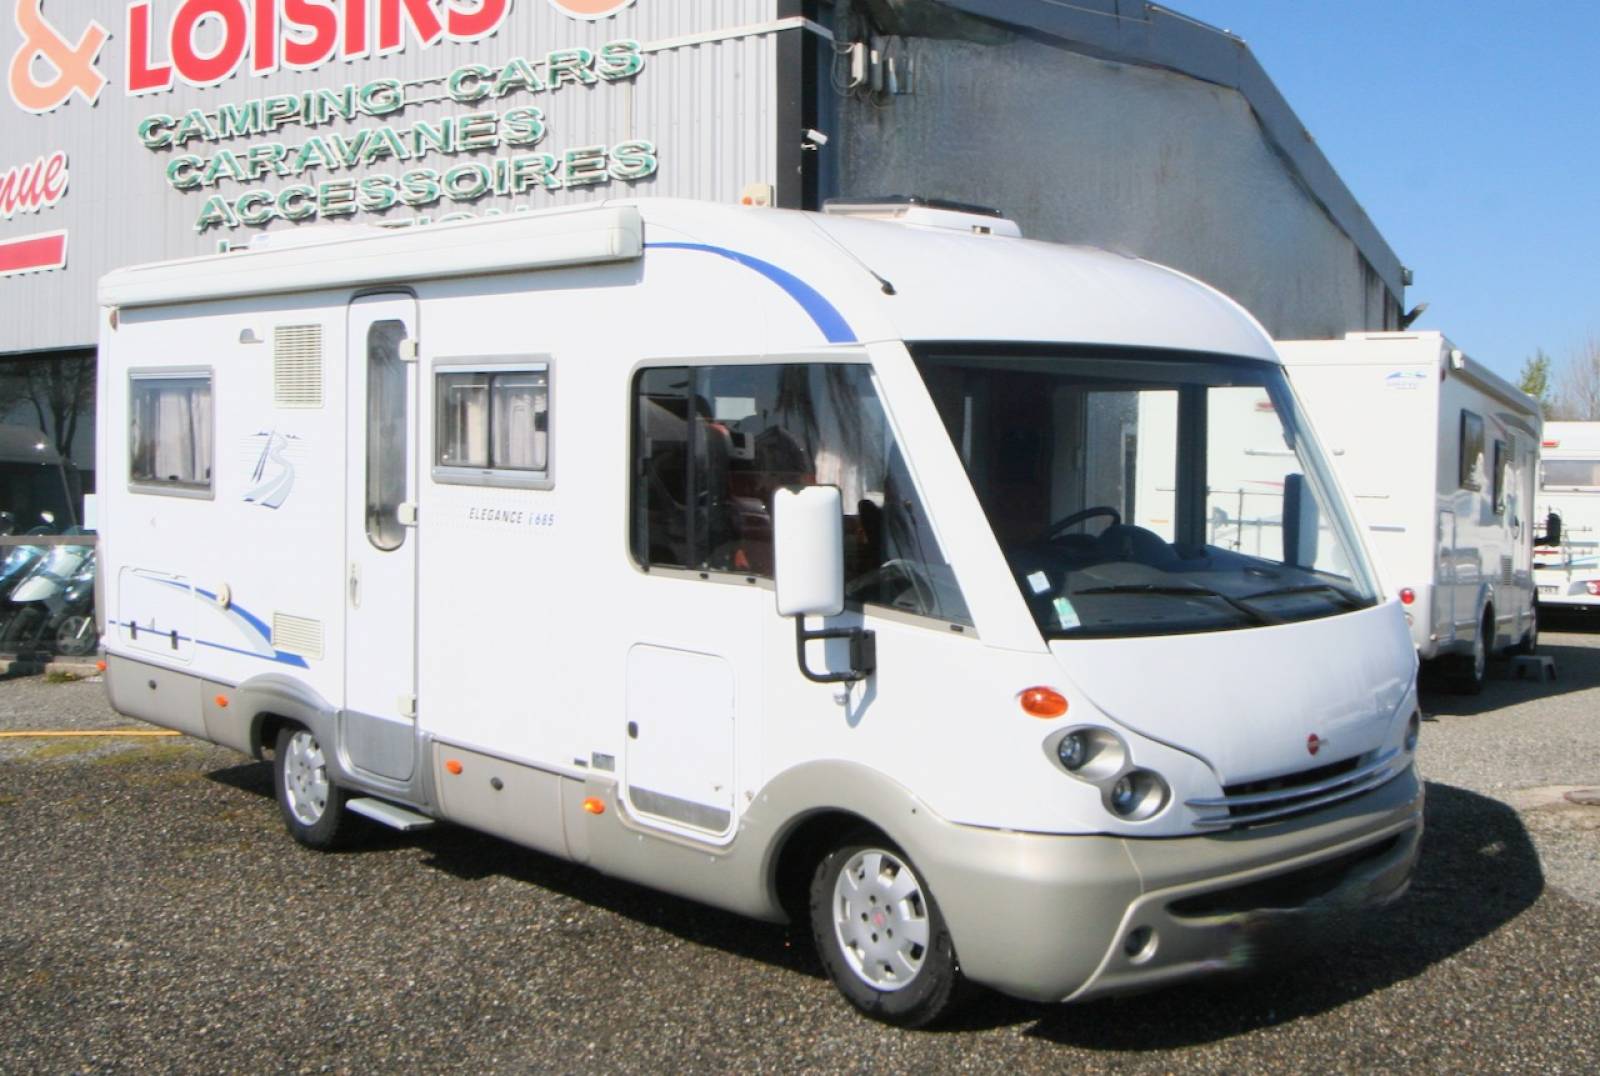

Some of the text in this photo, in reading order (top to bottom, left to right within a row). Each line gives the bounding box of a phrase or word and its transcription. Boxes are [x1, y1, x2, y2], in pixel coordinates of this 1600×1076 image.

[9, 0, 108, 113] &
[138, 39, 645, 150] CAMPING CARS
[165, 106, 547, 190] CARAVANES
[194, 140, 658, 231] ACCESSOIRES
[469, 507, 523, 523] ELEGANCE
